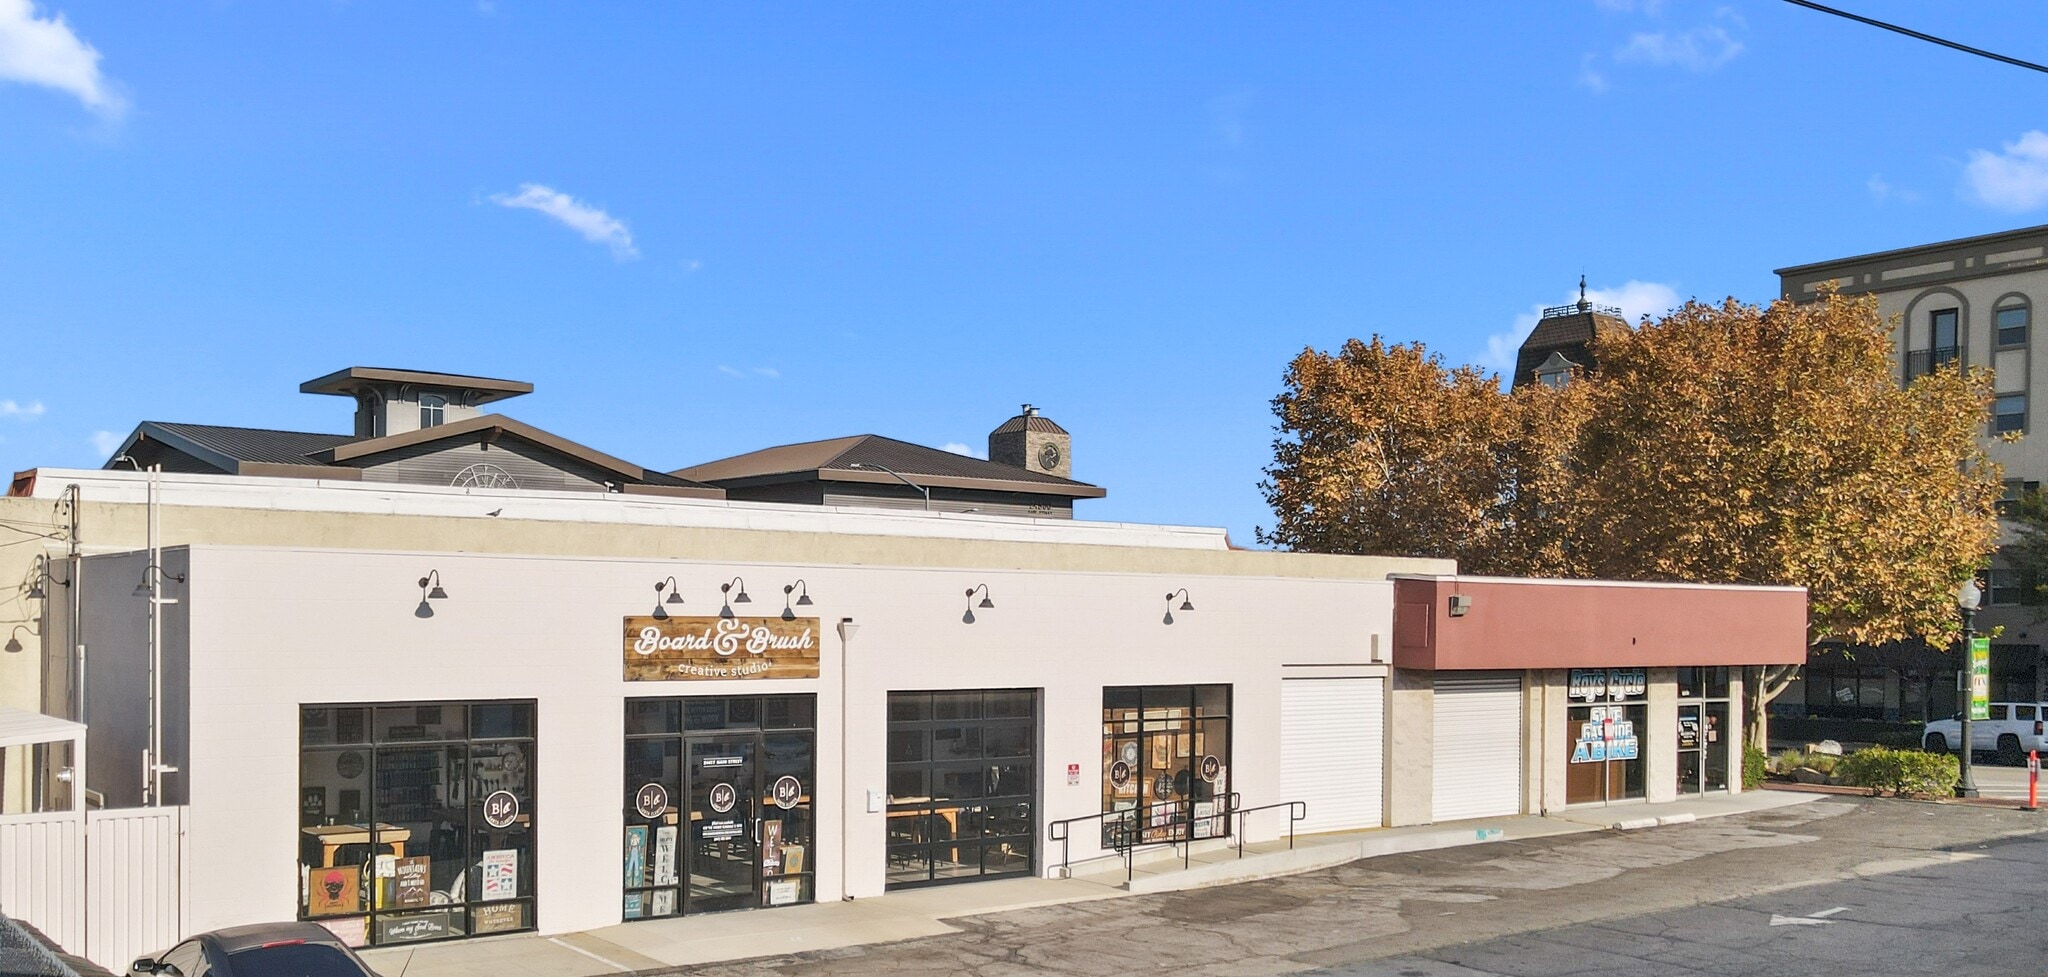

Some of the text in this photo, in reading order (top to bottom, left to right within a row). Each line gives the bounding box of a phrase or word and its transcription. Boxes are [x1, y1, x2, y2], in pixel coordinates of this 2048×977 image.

[634, 618, 813, 656] Board & Brush
[678, 663, 727, 677] creative
[1569, 668, 1645, 702] Roy's Cycle
[1571, 736, 1638, 763] A BIKE
[659, 845, 670, 913] WELCME
[483, 904, 515, 916] HOME
